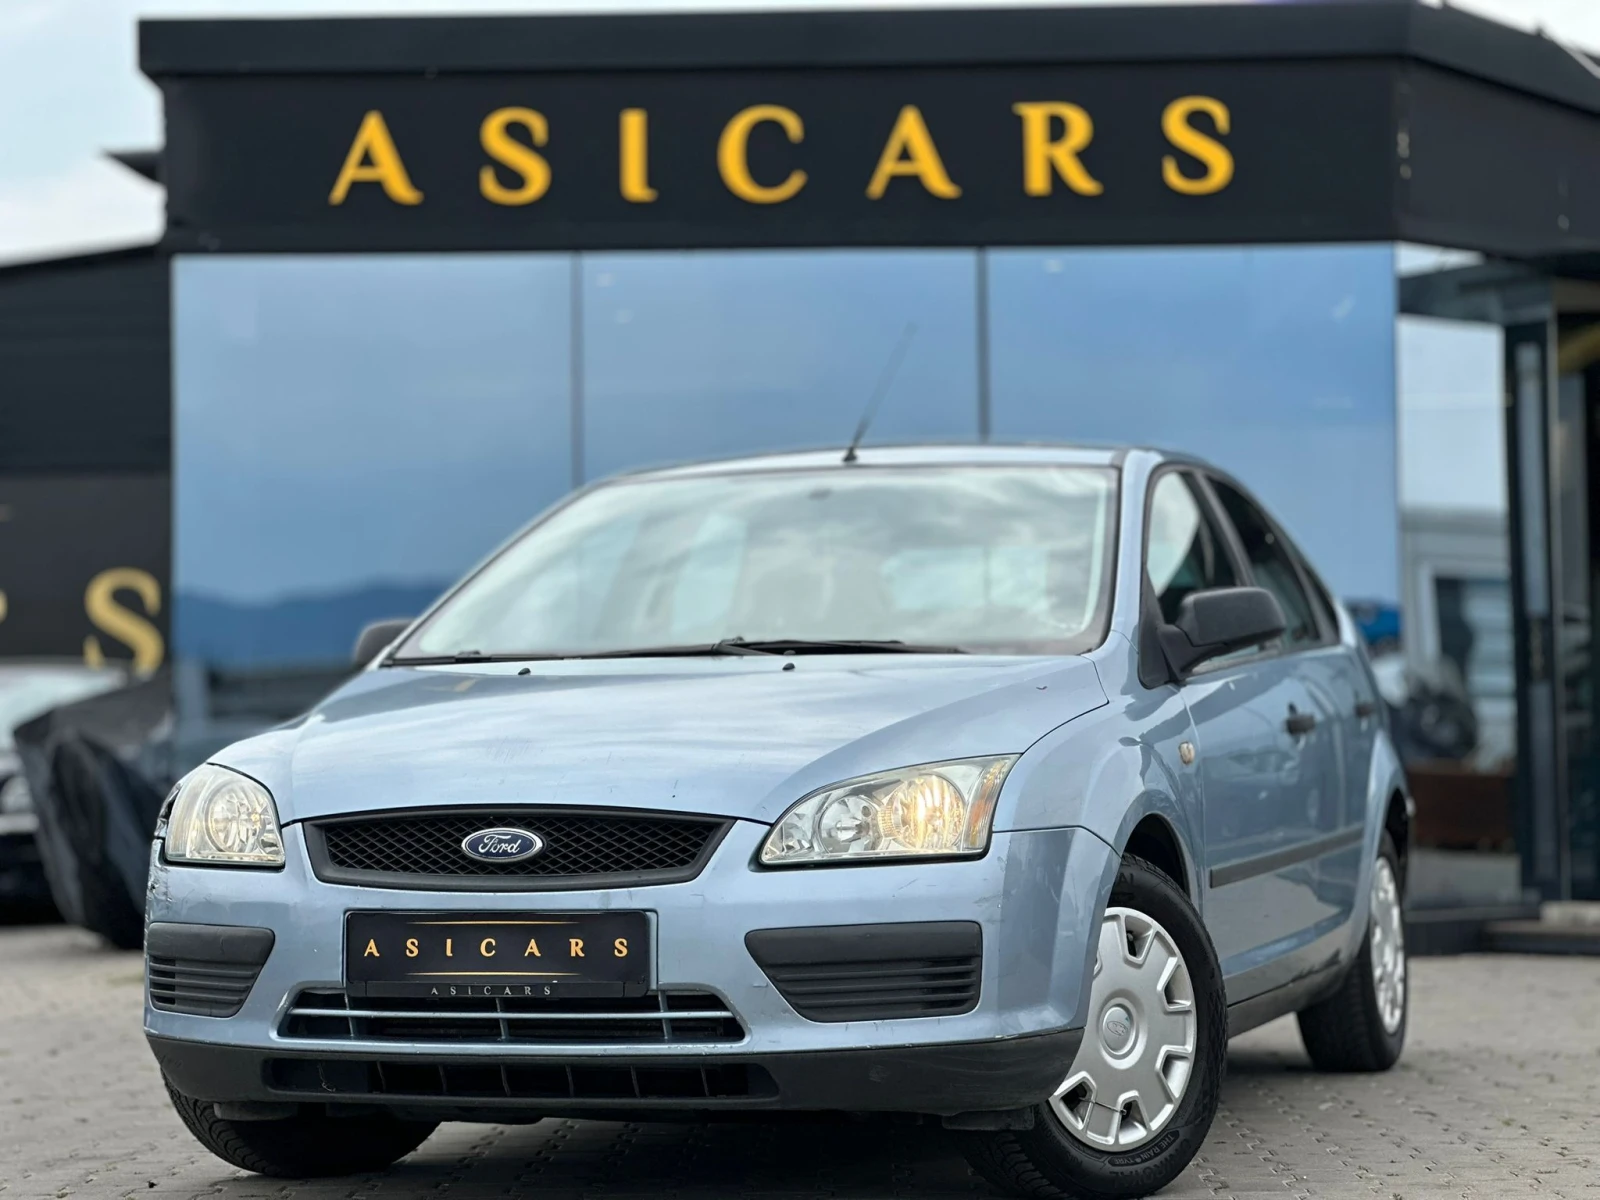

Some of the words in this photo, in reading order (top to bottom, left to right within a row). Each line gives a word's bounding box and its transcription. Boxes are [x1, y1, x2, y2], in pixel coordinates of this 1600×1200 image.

[330, 96, 1235, 206] ASICARS
[478, 834, 522, 854] Ford
[364, 938, 629, 958] ASICARS
[430, 986, 551, 996] ASICARS
[1160, 1134, 1174, 1149] THE
[1140, 1146, 1161, 1160] RAIN
